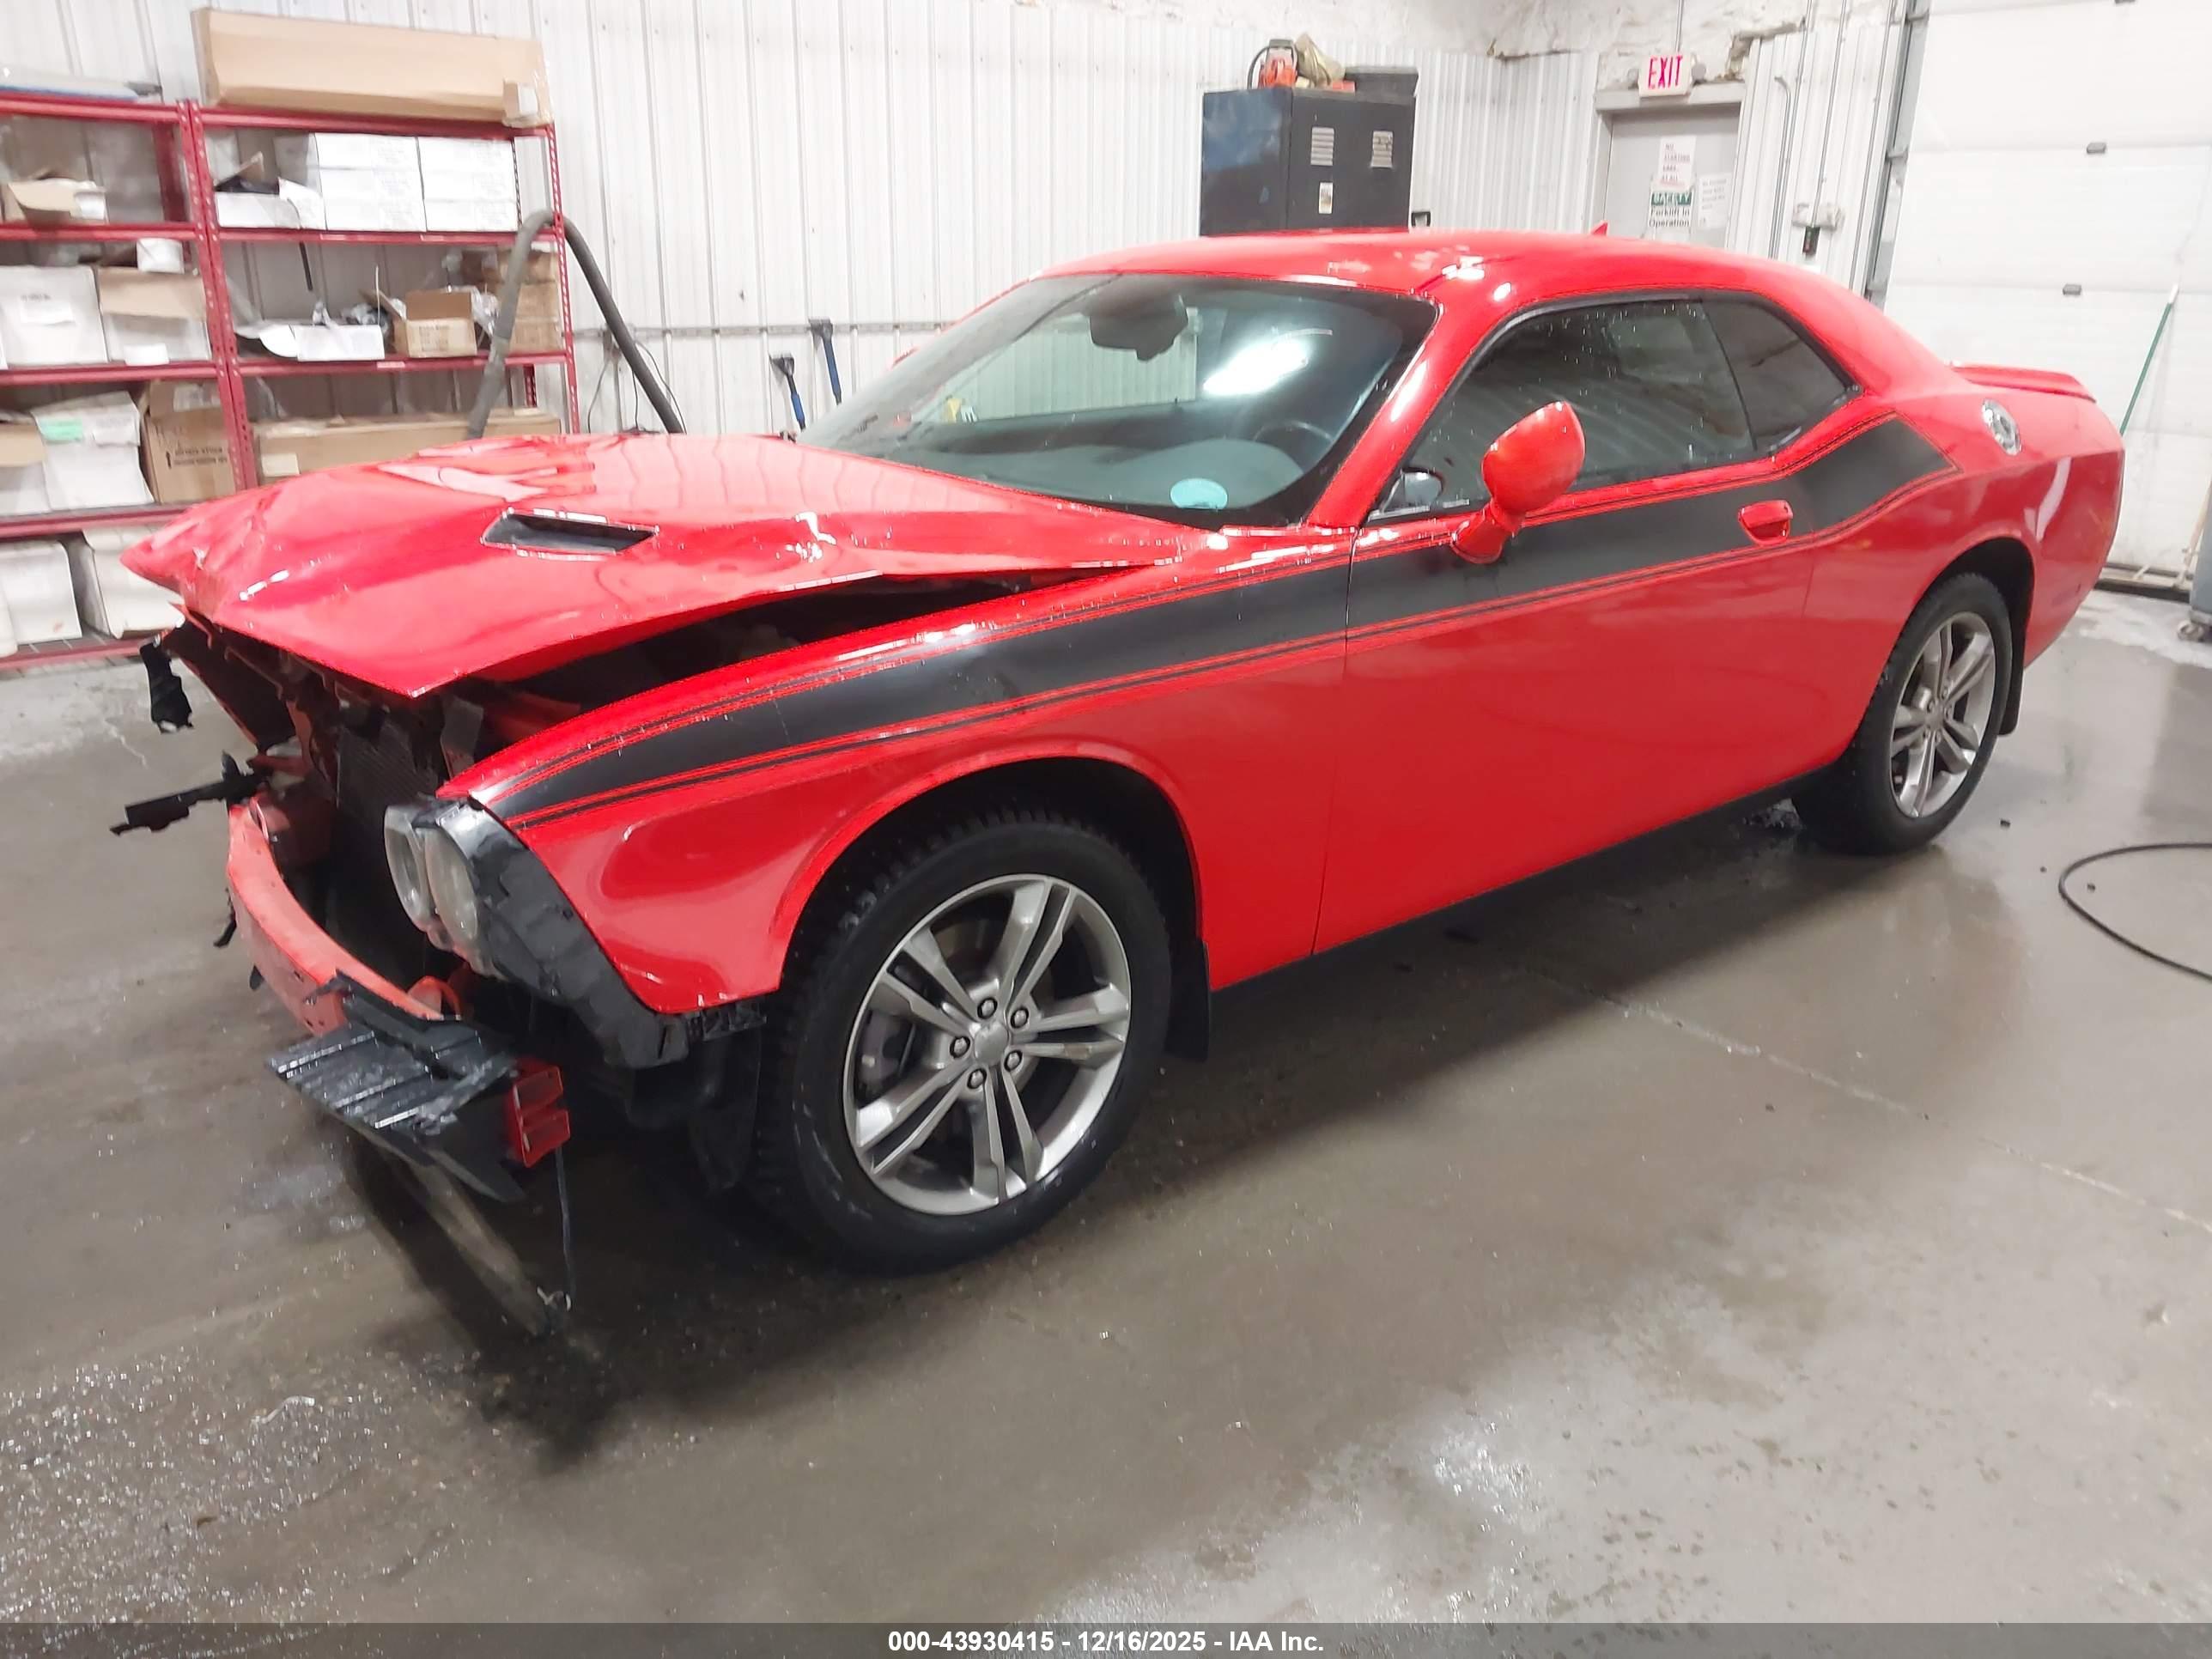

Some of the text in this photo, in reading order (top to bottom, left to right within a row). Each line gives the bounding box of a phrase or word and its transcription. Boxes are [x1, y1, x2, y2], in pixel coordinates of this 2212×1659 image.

[1648, 55, 1683, 89] EXIT
[1653, 192, 1690, 205] SAFETY
[1650, 207, 1680, 216] Forklift
[1649, 219, 1690, 228] Operation
